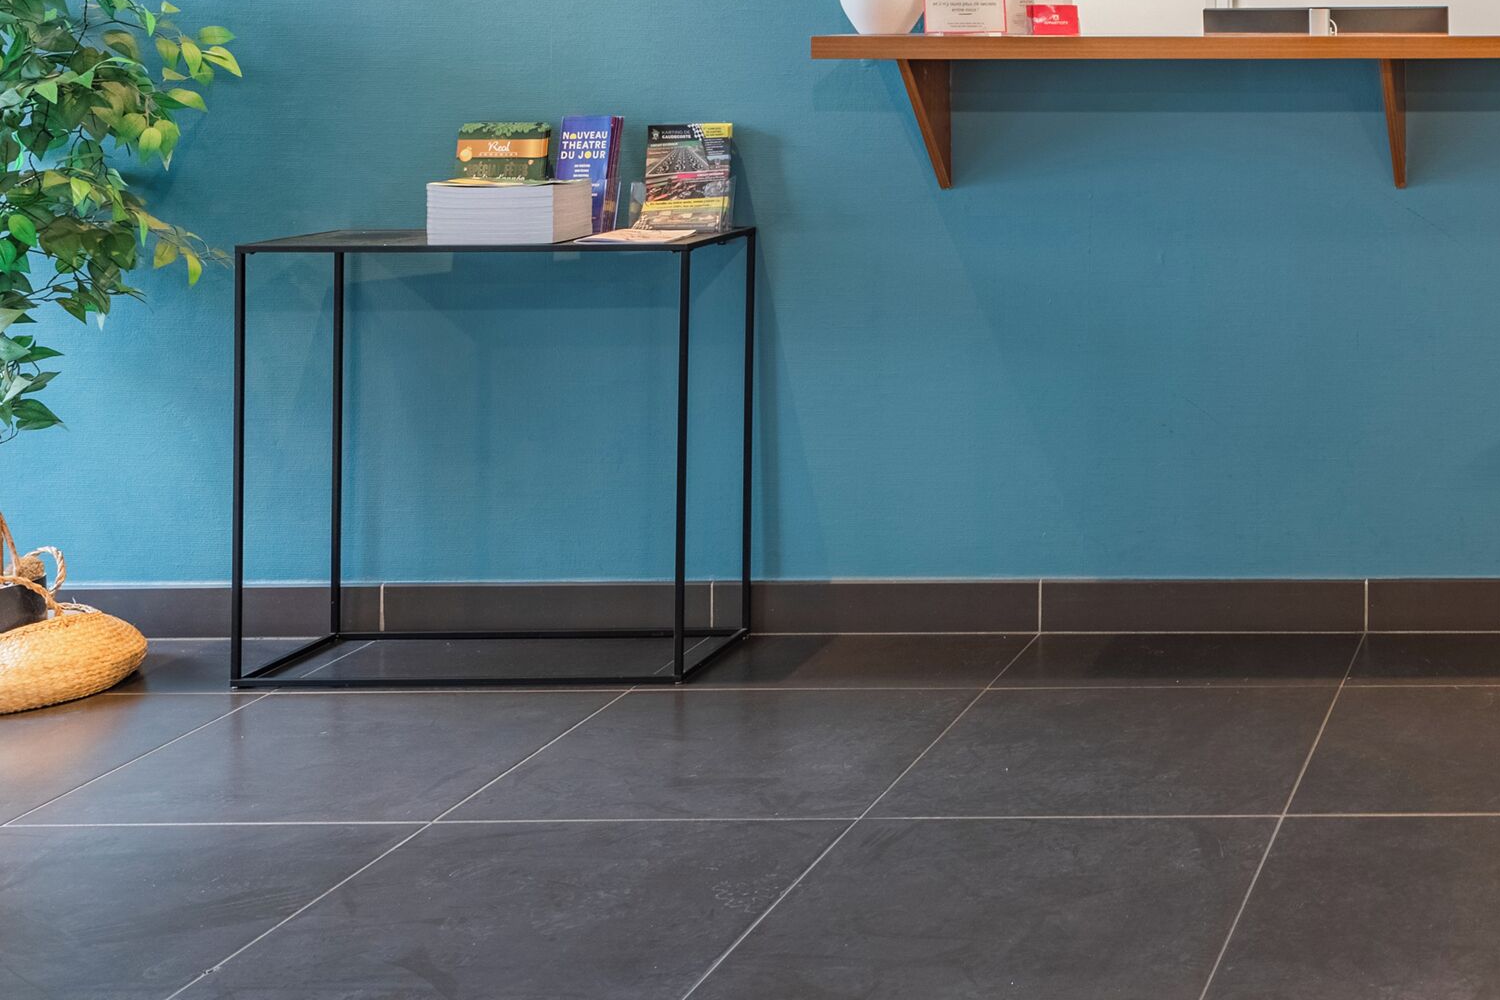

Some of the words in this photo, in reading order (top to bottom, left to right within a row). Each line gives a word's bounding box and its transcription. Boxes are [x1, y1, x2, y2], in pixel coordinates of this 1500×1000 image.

[561, 140, 607, 150] THEATRE
[560, 151, 575, 160] DU
[578, 150, 606, 159] JOUR
